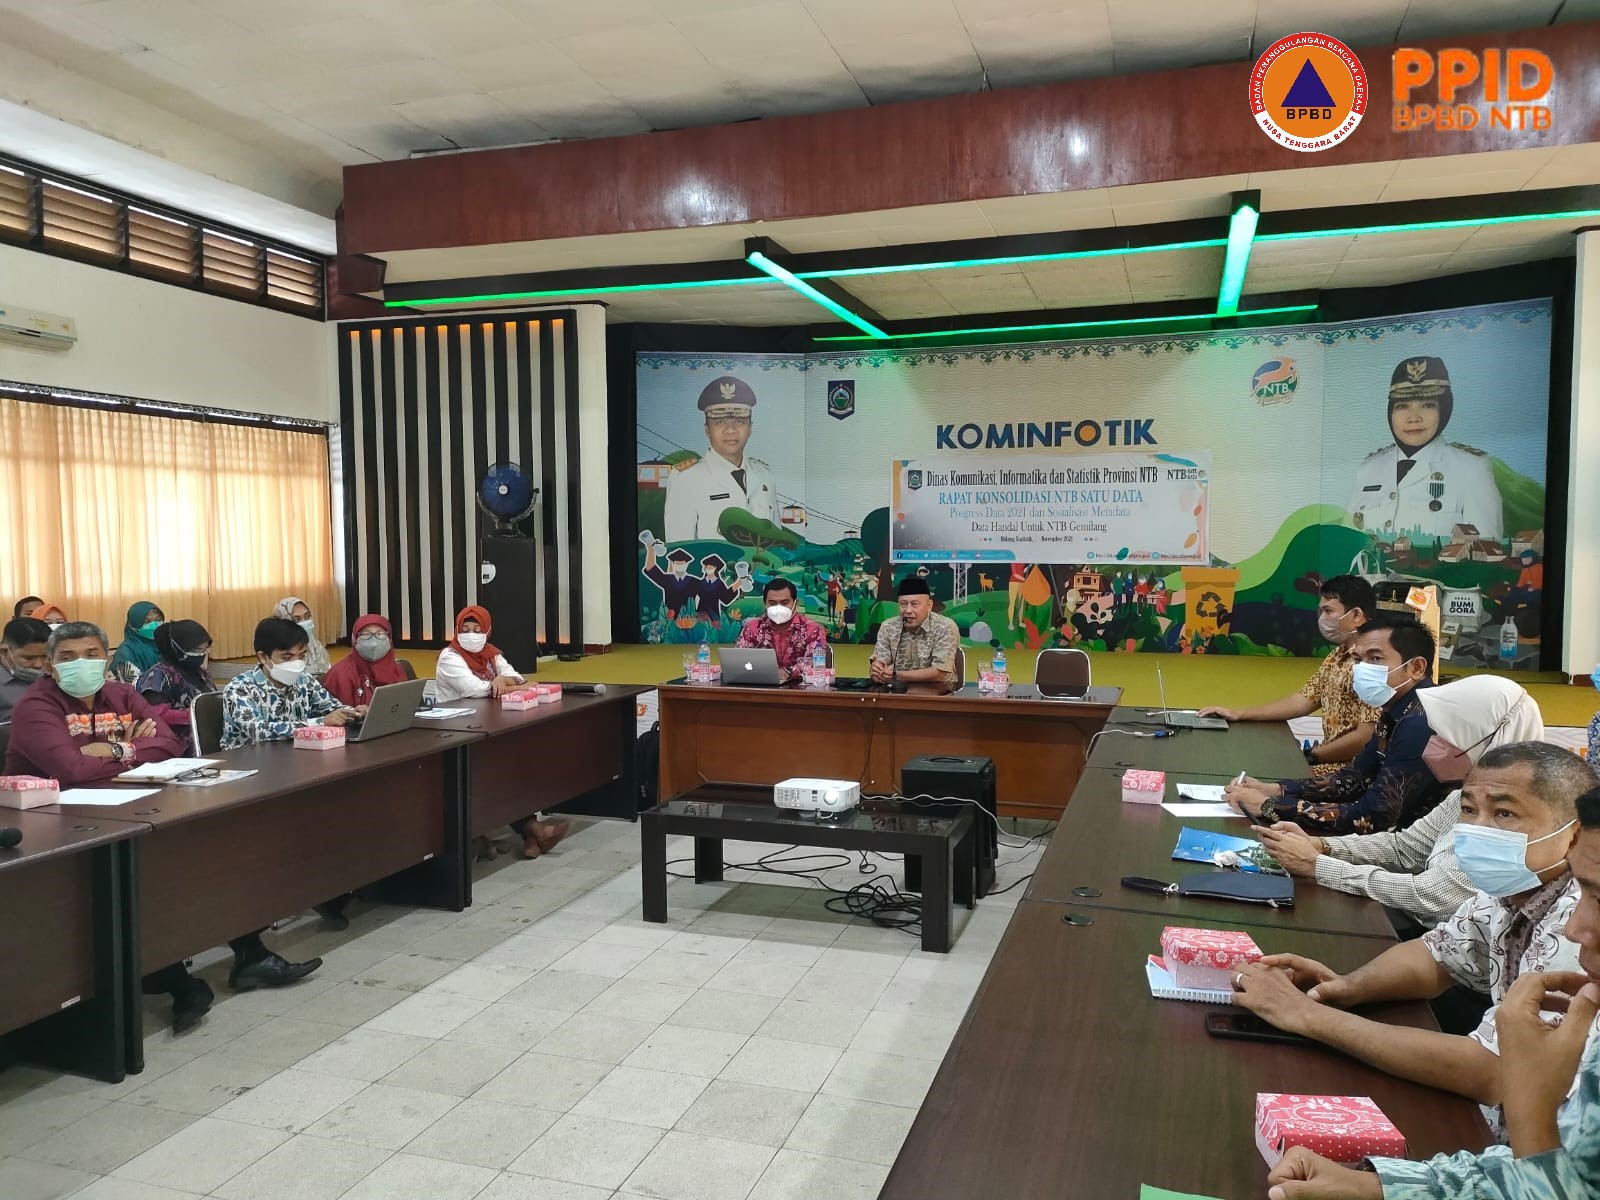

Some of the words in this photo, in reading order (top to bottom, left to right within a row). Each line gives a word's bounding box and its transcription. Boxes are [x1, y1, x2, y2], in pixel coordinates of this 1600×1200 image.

[1263, 383, 1289, 395] NTB
[936, 418, 1158, 449] KOMINFOTIK
[926, 470, 948, 487] Dinas
[1000, 468, 1047, 486] Informatika
[1050, 468, 1065, 484] dan
[1066, 467, 1101, 484] Statistik
[1103, 467, 1138, 483] Provinsi
[1139, 466, 1158, 483] NTB
[1167, 469, 1187, 480] NTB
[939, 492, 973, 505] RAPAT
[975, 491, 1050, 504] KONSOLIDASI
[1055, 490, 1078, 503] NTB
[1081, 490, 1110, 503] SATU
[1113, 489, 1143, 503] DATA
[986, 507, 1004, 518] Data
[1007, 506, 1026, 518] 2021
[1029, 506, 1045, 517] dan
[1047, 506, 1088, 517] Sosialisasi
[971, 522, 989, 532] Data
[991, 521, 1018, 532] Handal
[1021, 521, 1045, 532] Untuk
[1047, 521, 1067, 532] NTB
[1069, 521, 1107, 533] Gemilang
